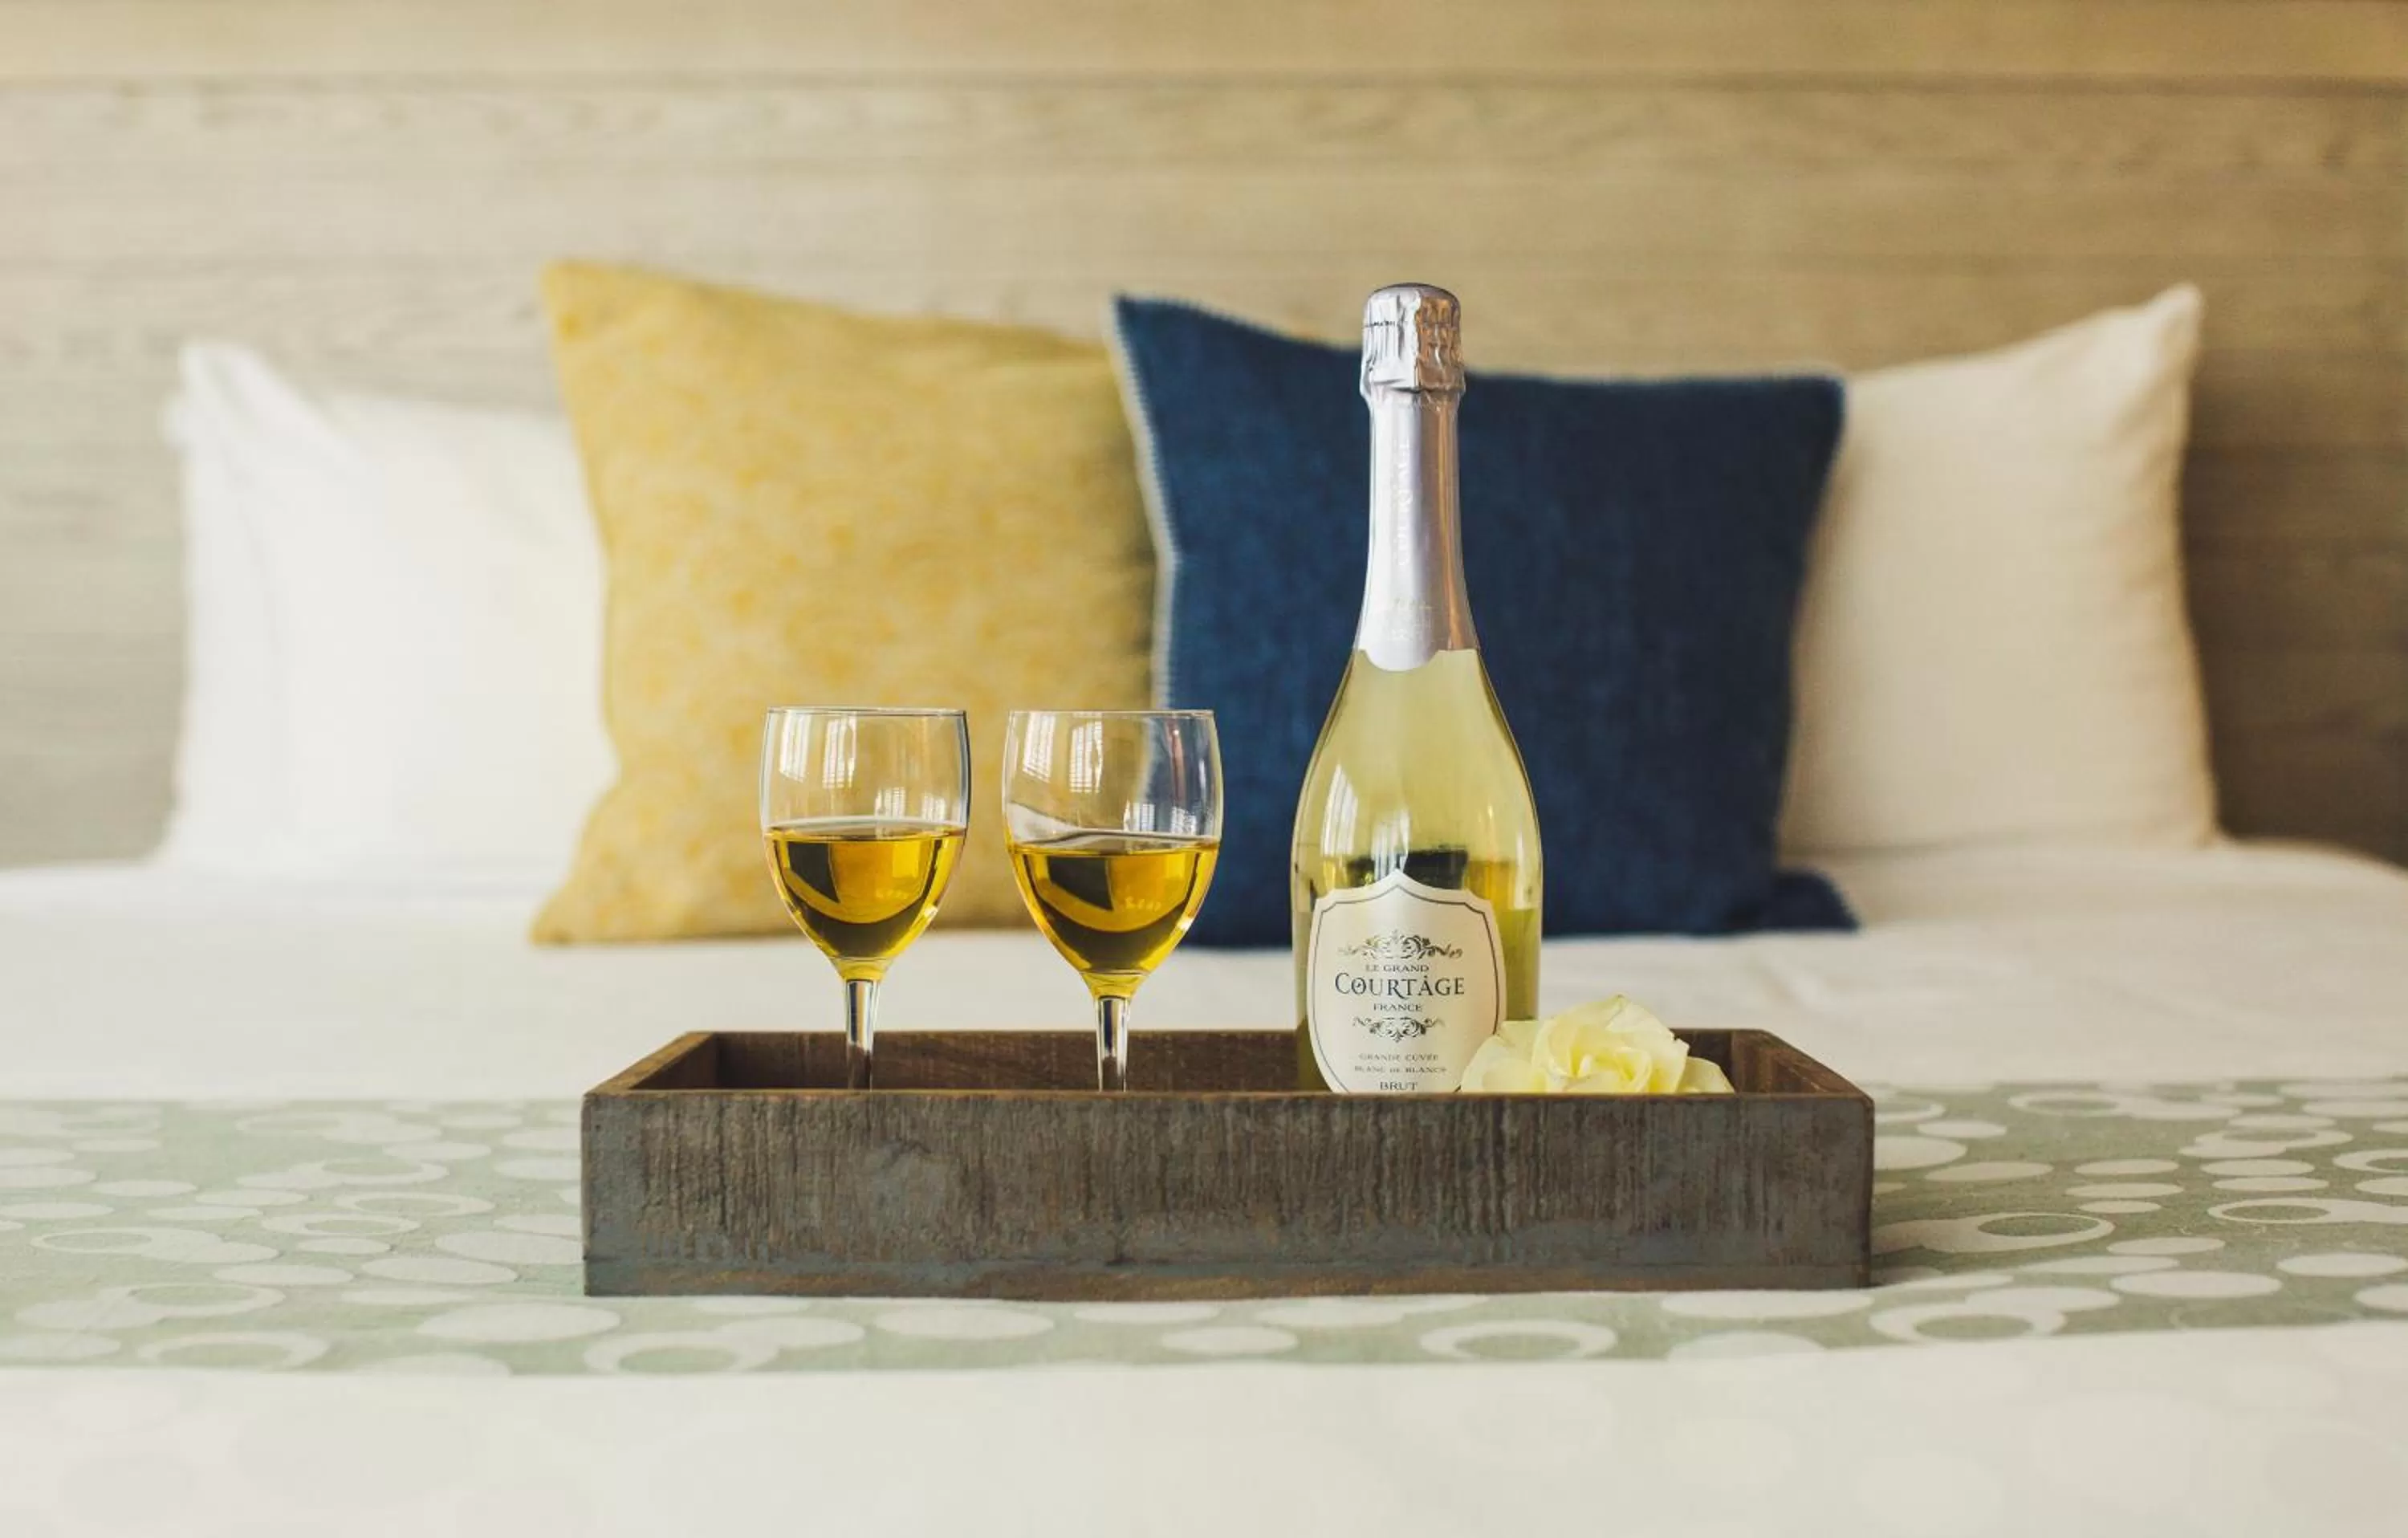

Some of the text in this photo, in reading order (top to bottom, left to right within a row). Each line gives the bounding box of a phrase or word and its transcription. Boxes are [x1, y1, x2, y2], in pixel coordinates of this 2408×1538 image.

[1365, 964, 1430, 972] LE GRAND
[1373, 1003, 1423, 1011] FRANCE
[1380, 1081, 1418, 1090] BRUT
